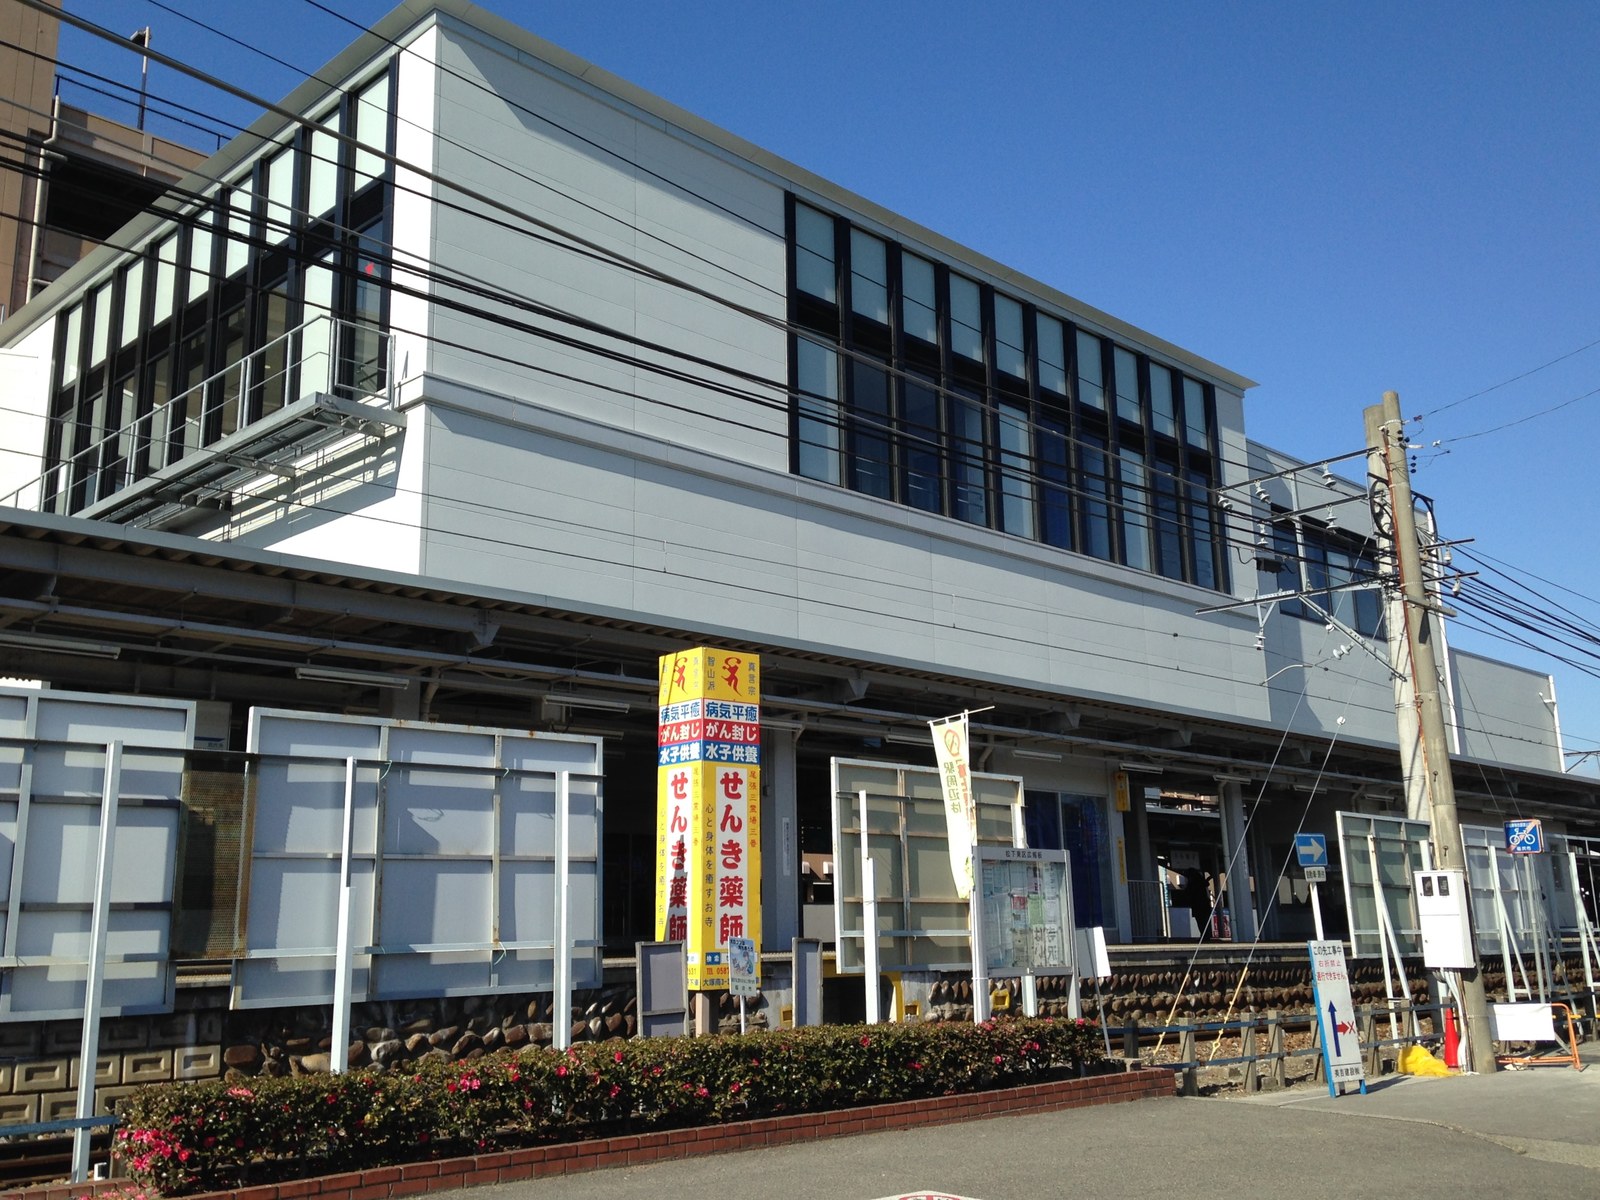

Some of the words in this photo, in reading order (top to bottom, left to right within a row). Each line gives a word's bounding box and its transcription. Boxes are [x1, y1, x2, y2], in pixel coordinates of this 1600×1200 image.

[660, 701, 700, 722] 病気平癒
[705, 701, 758, 722] 病気平癒
[660, 722, 700, 742] がん封じ
[705, 722, 757, 742] がん封じ
[660, 743, 700, 764] 水子供養
[705, 743, 758, 764] 水子供養
[669, 771, 688, 941] せんき薬師
[705, 804, 713, 927] 心と身体を癒すお寺
[719, 771, 743, 945] せんき薬師
[1313, 945, 1342, 955] この先工事中
